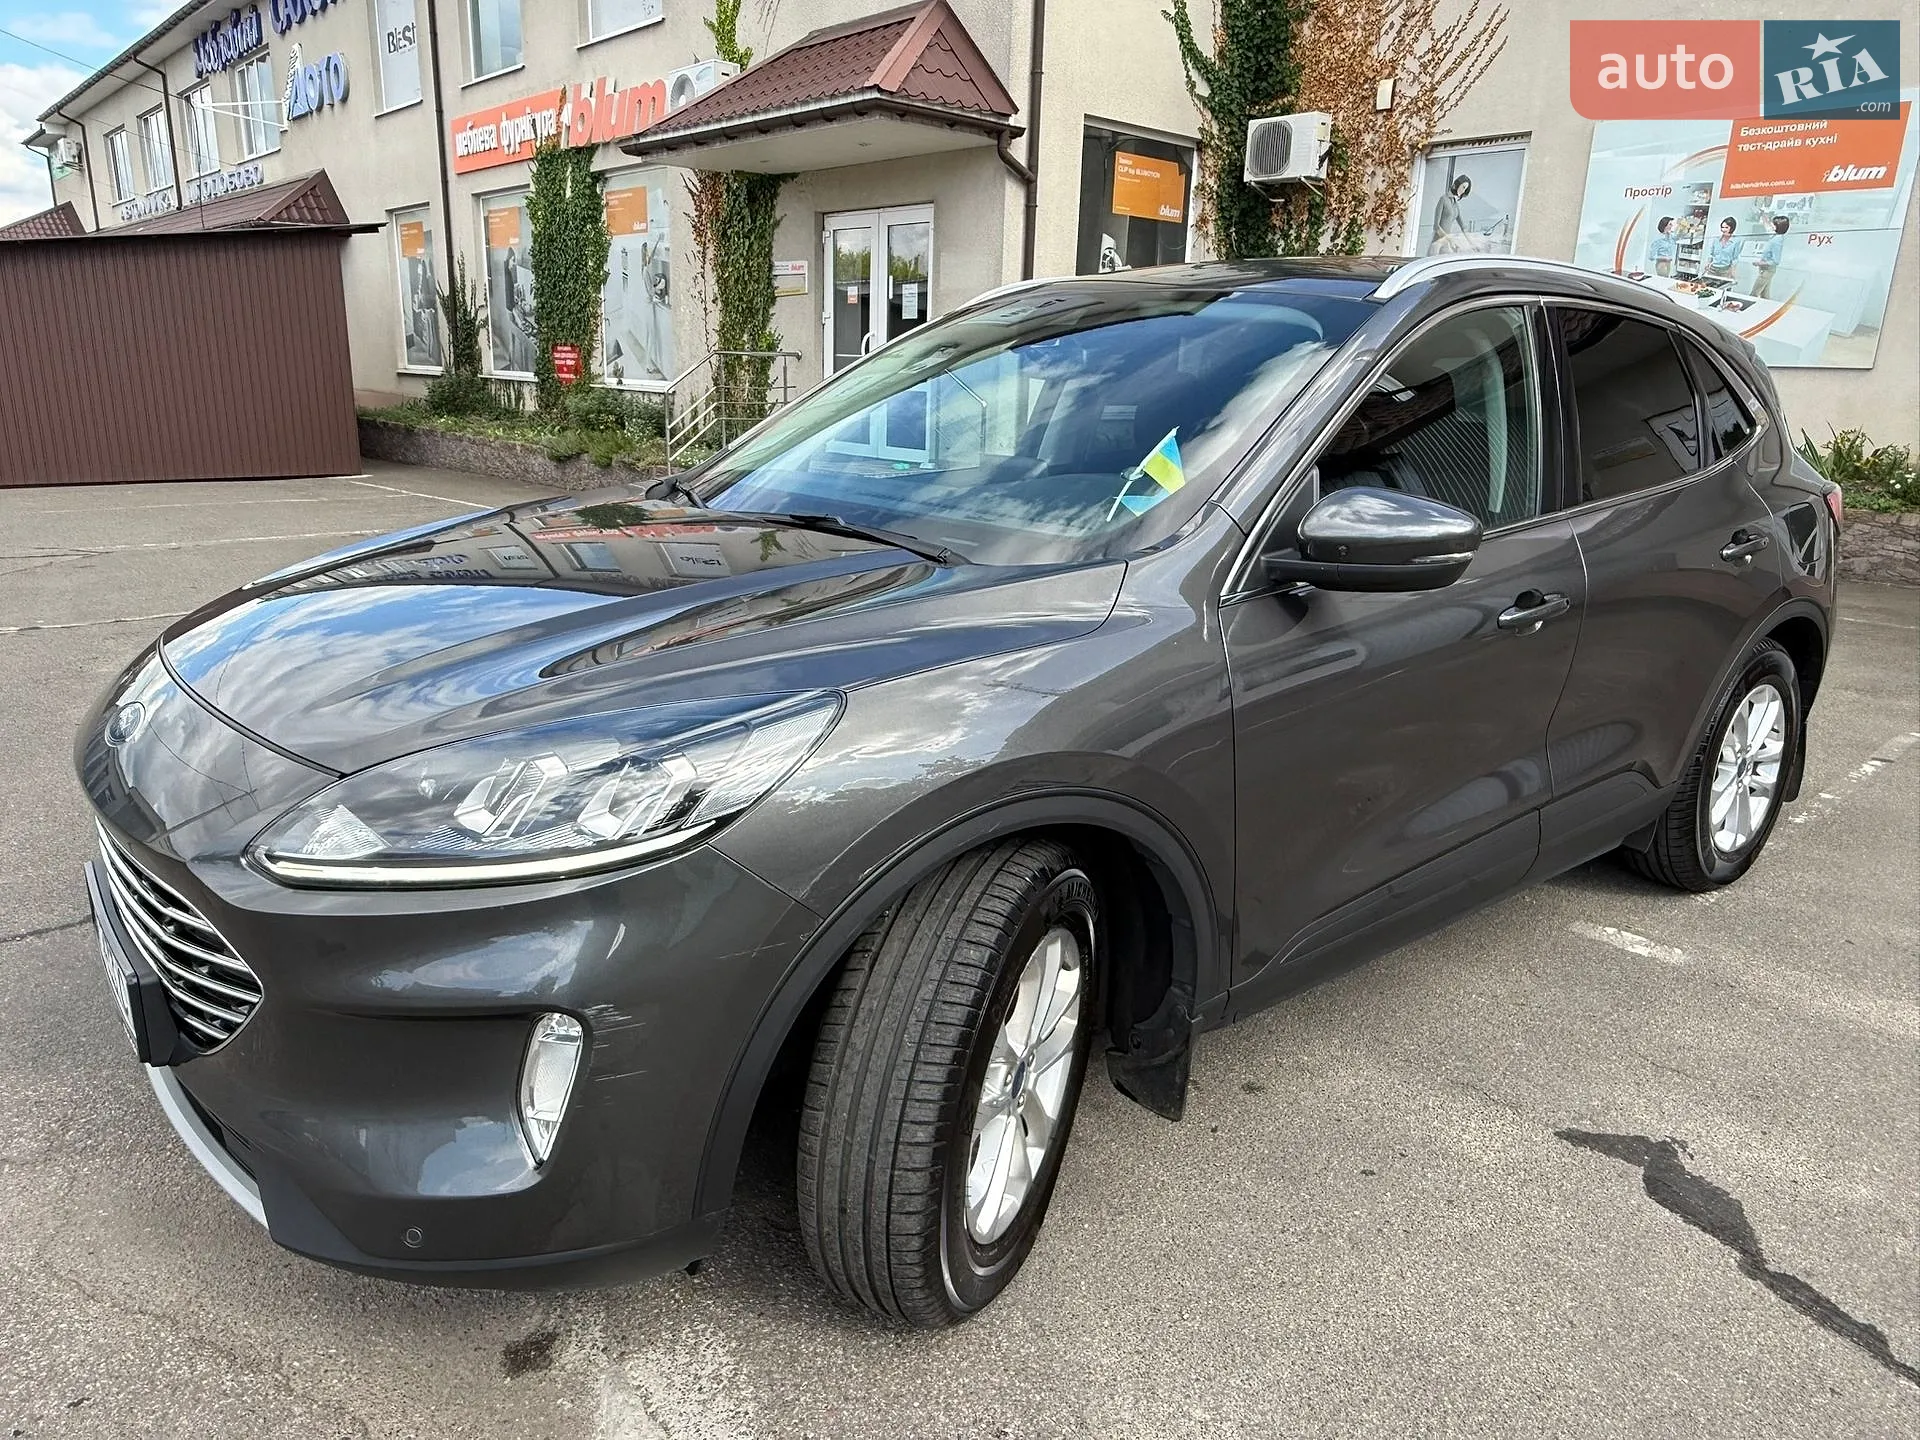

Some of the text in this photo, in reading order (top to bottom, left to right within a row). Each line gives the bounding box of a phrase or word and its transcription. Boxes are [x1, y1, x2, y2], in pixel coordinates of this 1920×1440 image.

[569, 77, 667, 148] blum
[1740, 119, 1828, 137] Безкоштовний
[455, 121, 497, 158] меблева
[1737, 132, 1839, 152] тест-драйв кухні
[1827, 163, 1888, 183] blum
[1624, 183, 1672, 199] Простір
[1159, 204, 1181, 218] blum
[1807, 232, 1834, 247] Рух
